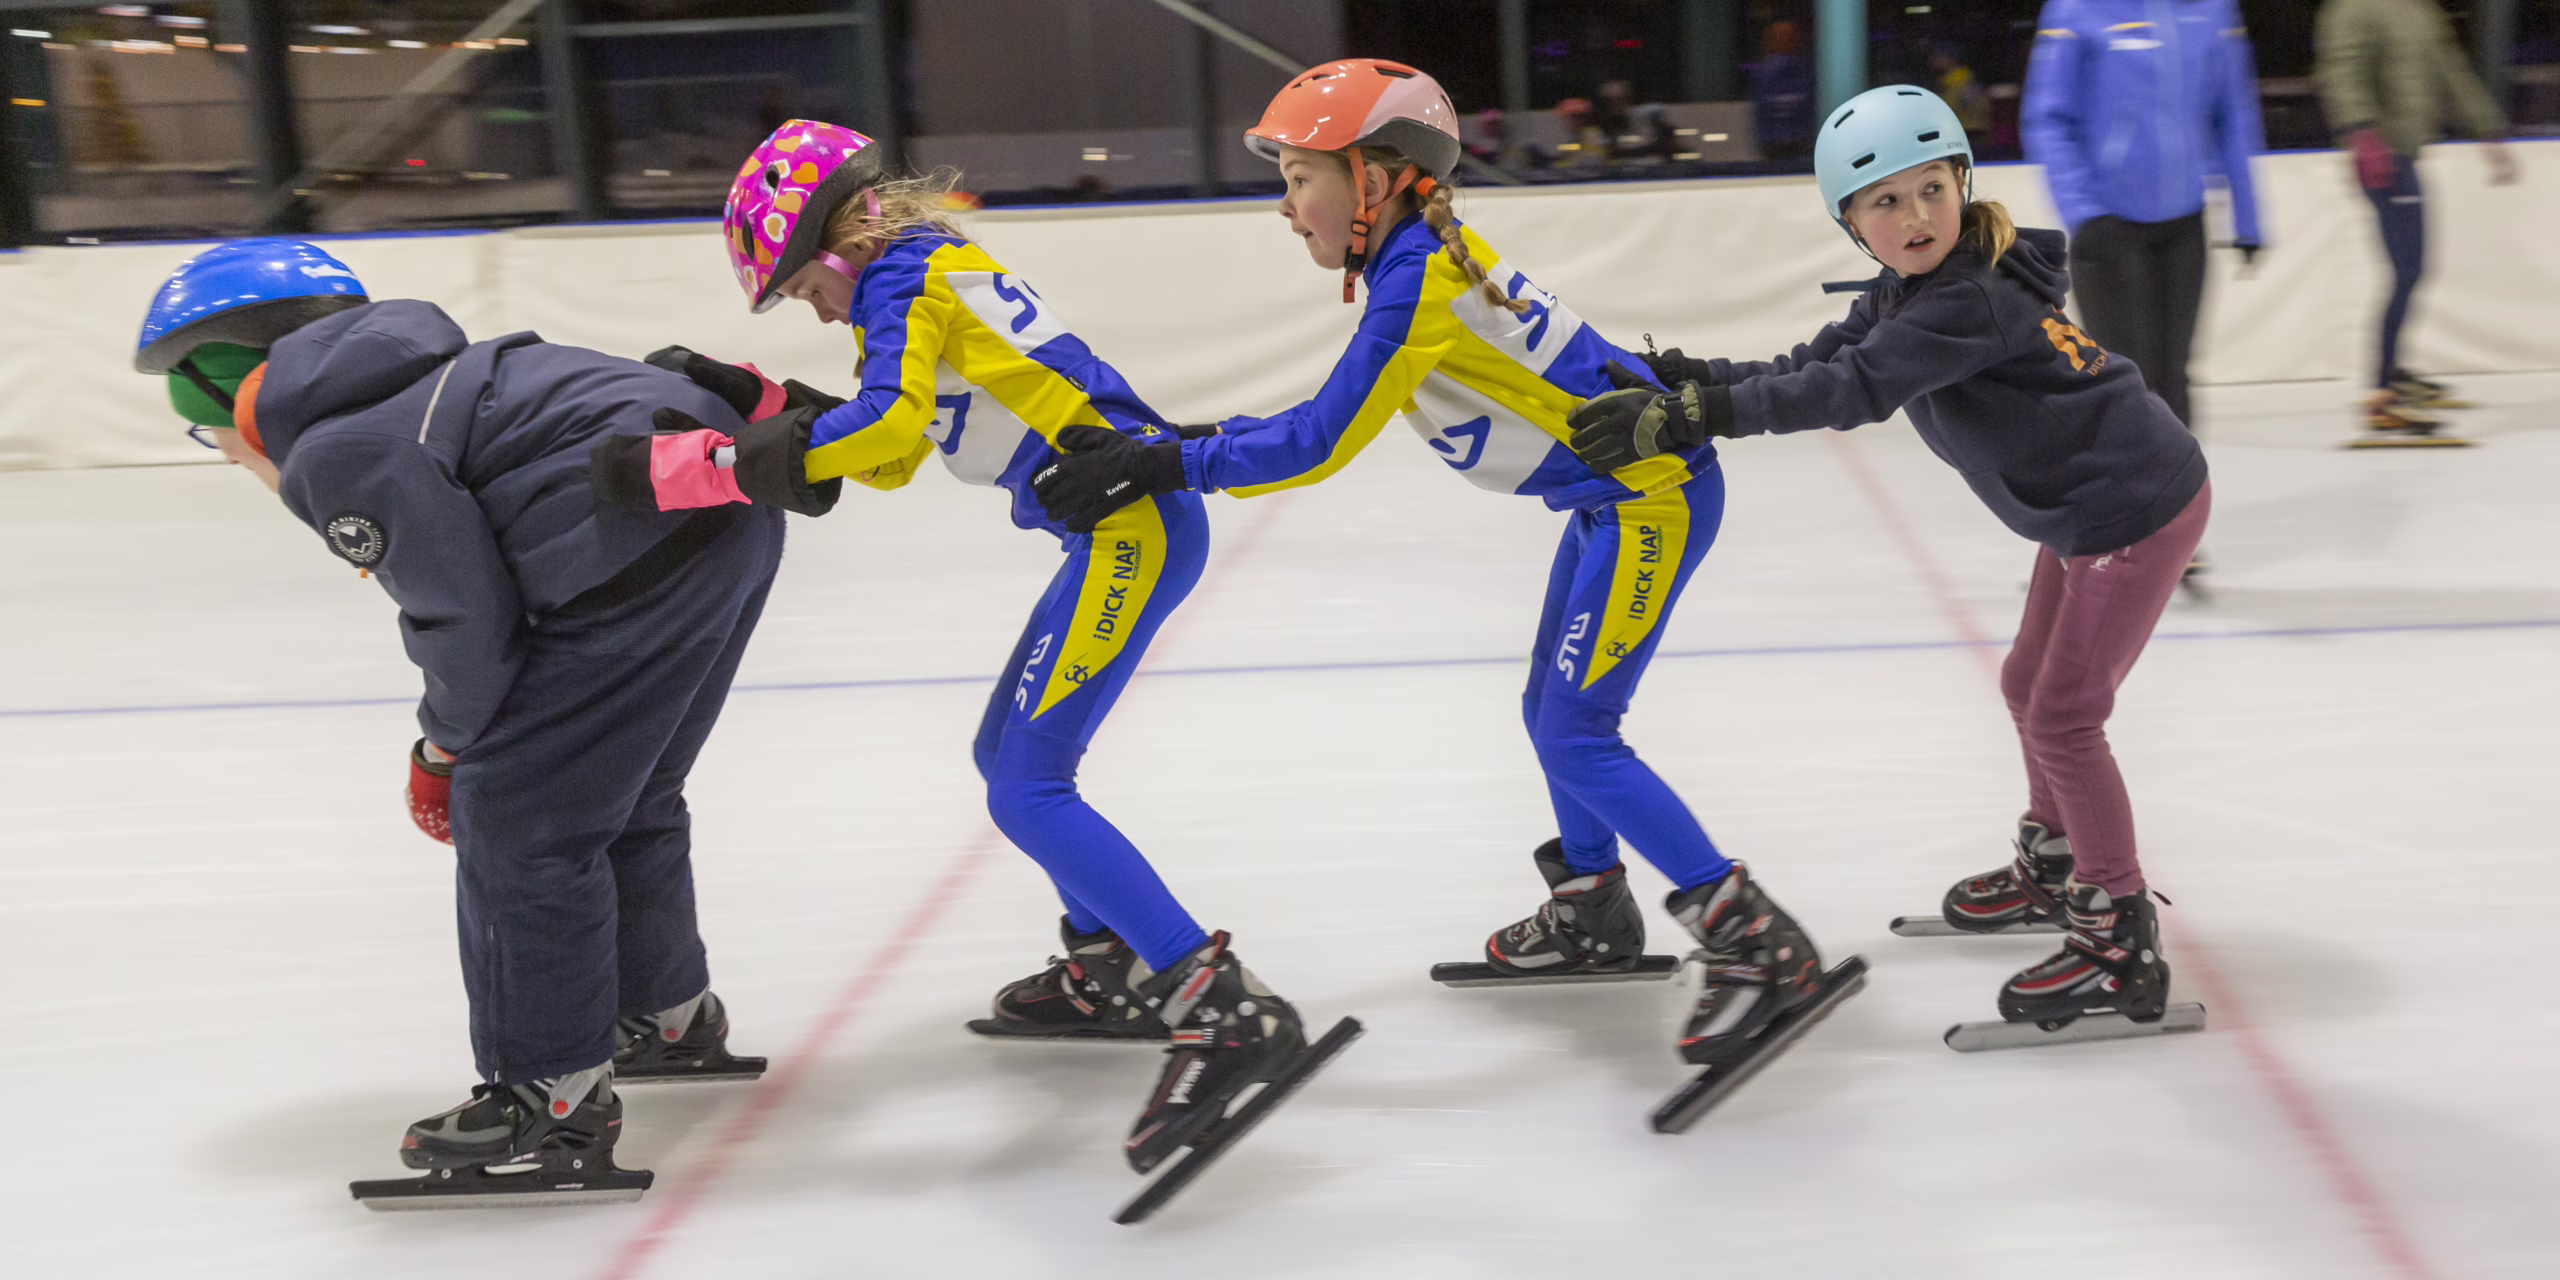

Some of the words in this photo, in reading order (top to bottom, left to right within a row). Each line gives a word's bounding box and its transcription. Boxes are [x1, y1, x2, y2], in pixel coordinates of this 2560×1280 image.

[1640, 525, 1658, 563] NAP
[1095, 585, 1128, 635] DICK
[1112, 540, 1135, 580] NAP
[1629, 569, 1655, 615] DICK
